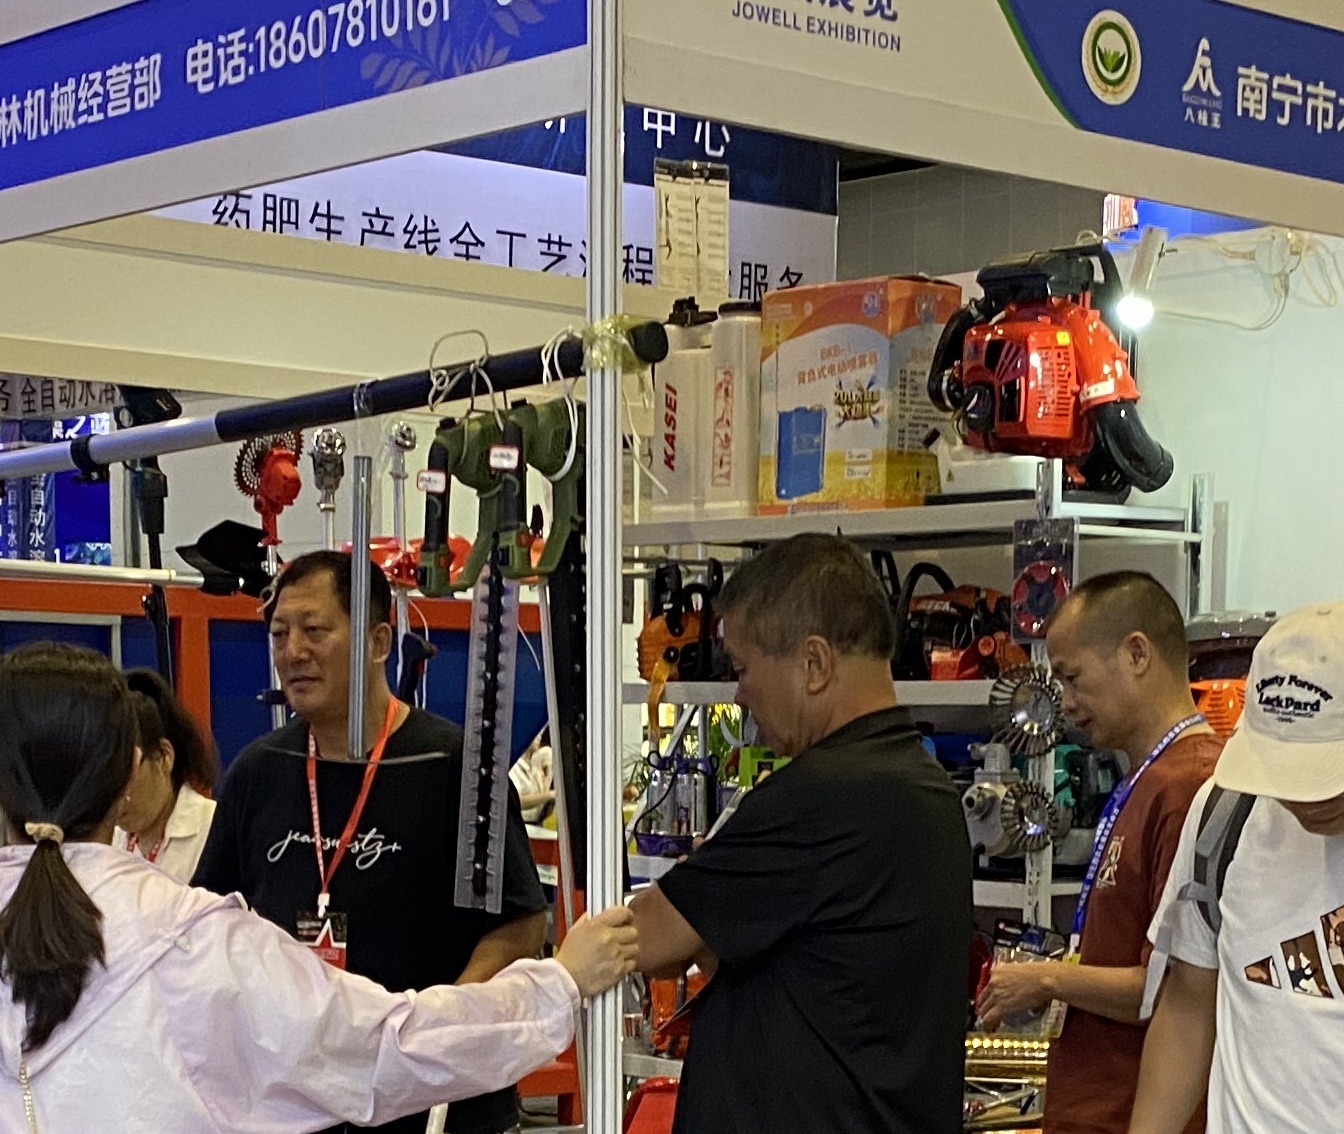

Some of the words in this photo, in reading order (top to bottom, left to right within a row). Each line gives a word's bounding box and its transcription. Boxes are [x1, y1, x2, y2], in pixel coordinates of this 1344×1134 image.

[732, 1, 802, 32] JOWELL
[806, 15, 902, 53] EXHIBITION
[663, 382, 677, 472] KASEI
[1288, 674, 1333, 702] Forever
